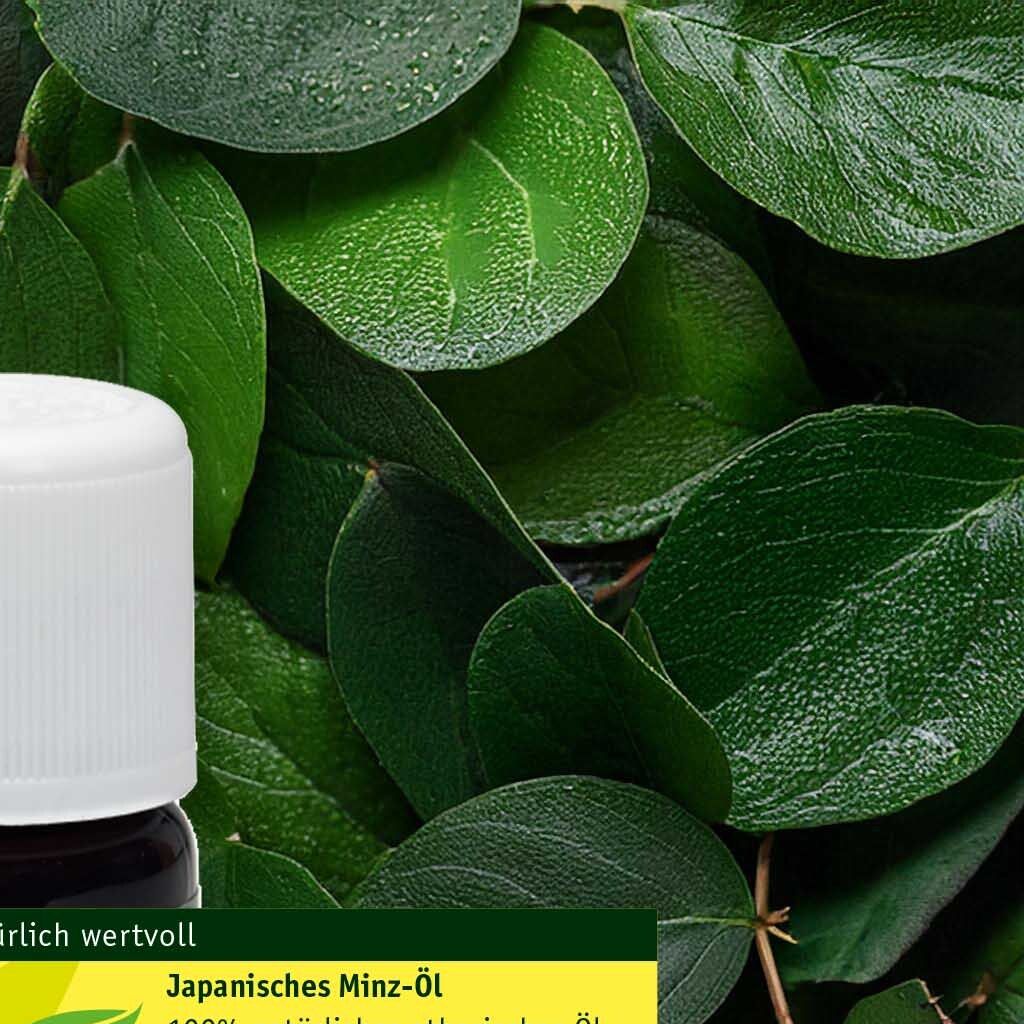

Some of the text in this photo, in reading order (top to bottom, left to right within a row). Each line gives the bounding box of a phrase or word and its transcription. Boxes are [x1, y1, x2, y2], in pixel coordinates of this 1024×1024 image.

[82, 922, 195, 946] wertvoll
[167, 967, 442, 1003] Japanisches Minz-Öl
